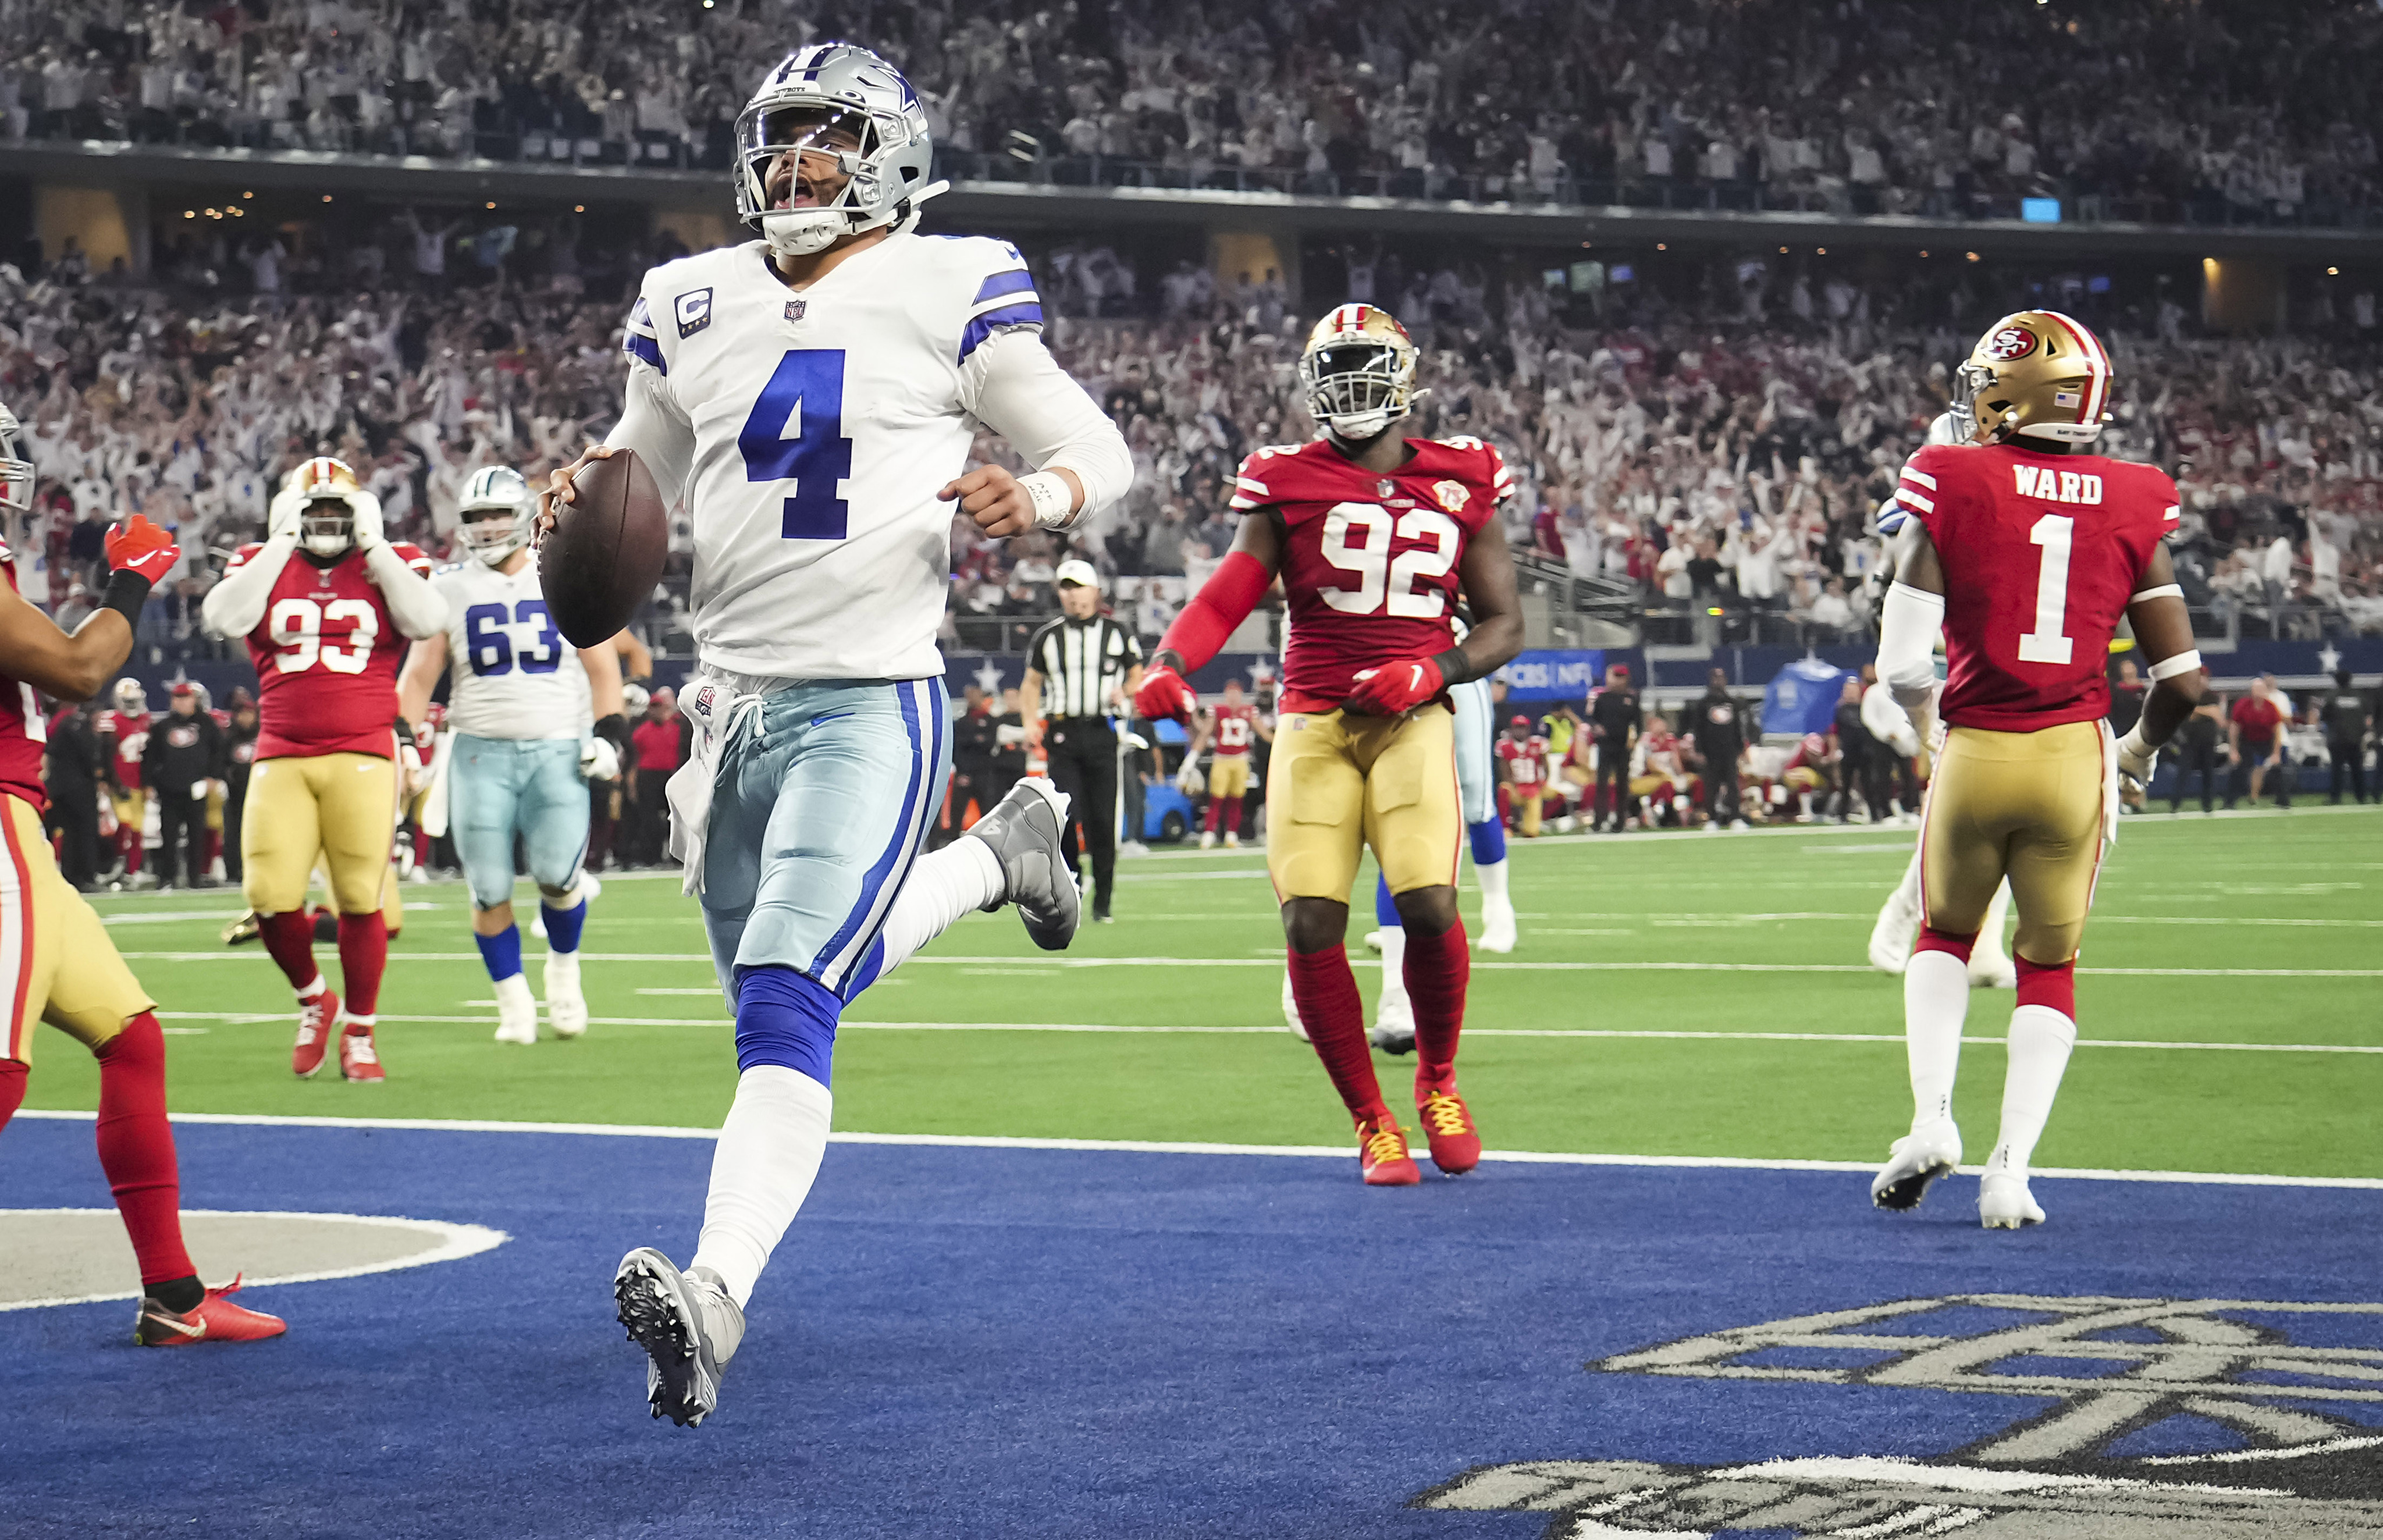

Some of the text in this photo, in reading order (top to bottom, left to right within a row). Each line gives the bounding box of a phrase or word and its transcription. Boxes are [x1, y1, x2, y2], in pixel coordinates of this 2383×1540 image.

[677, 290, 710, 325] C
[738, 348, 853, 539] 4
[2012, 464, 2103, 505] WARD
[1317, 502, 1460, 618] 92
[2017, 514, 2074, 664] 1
[269, 598, 379, 675] 93
[466, 599, 562, 677] 63
